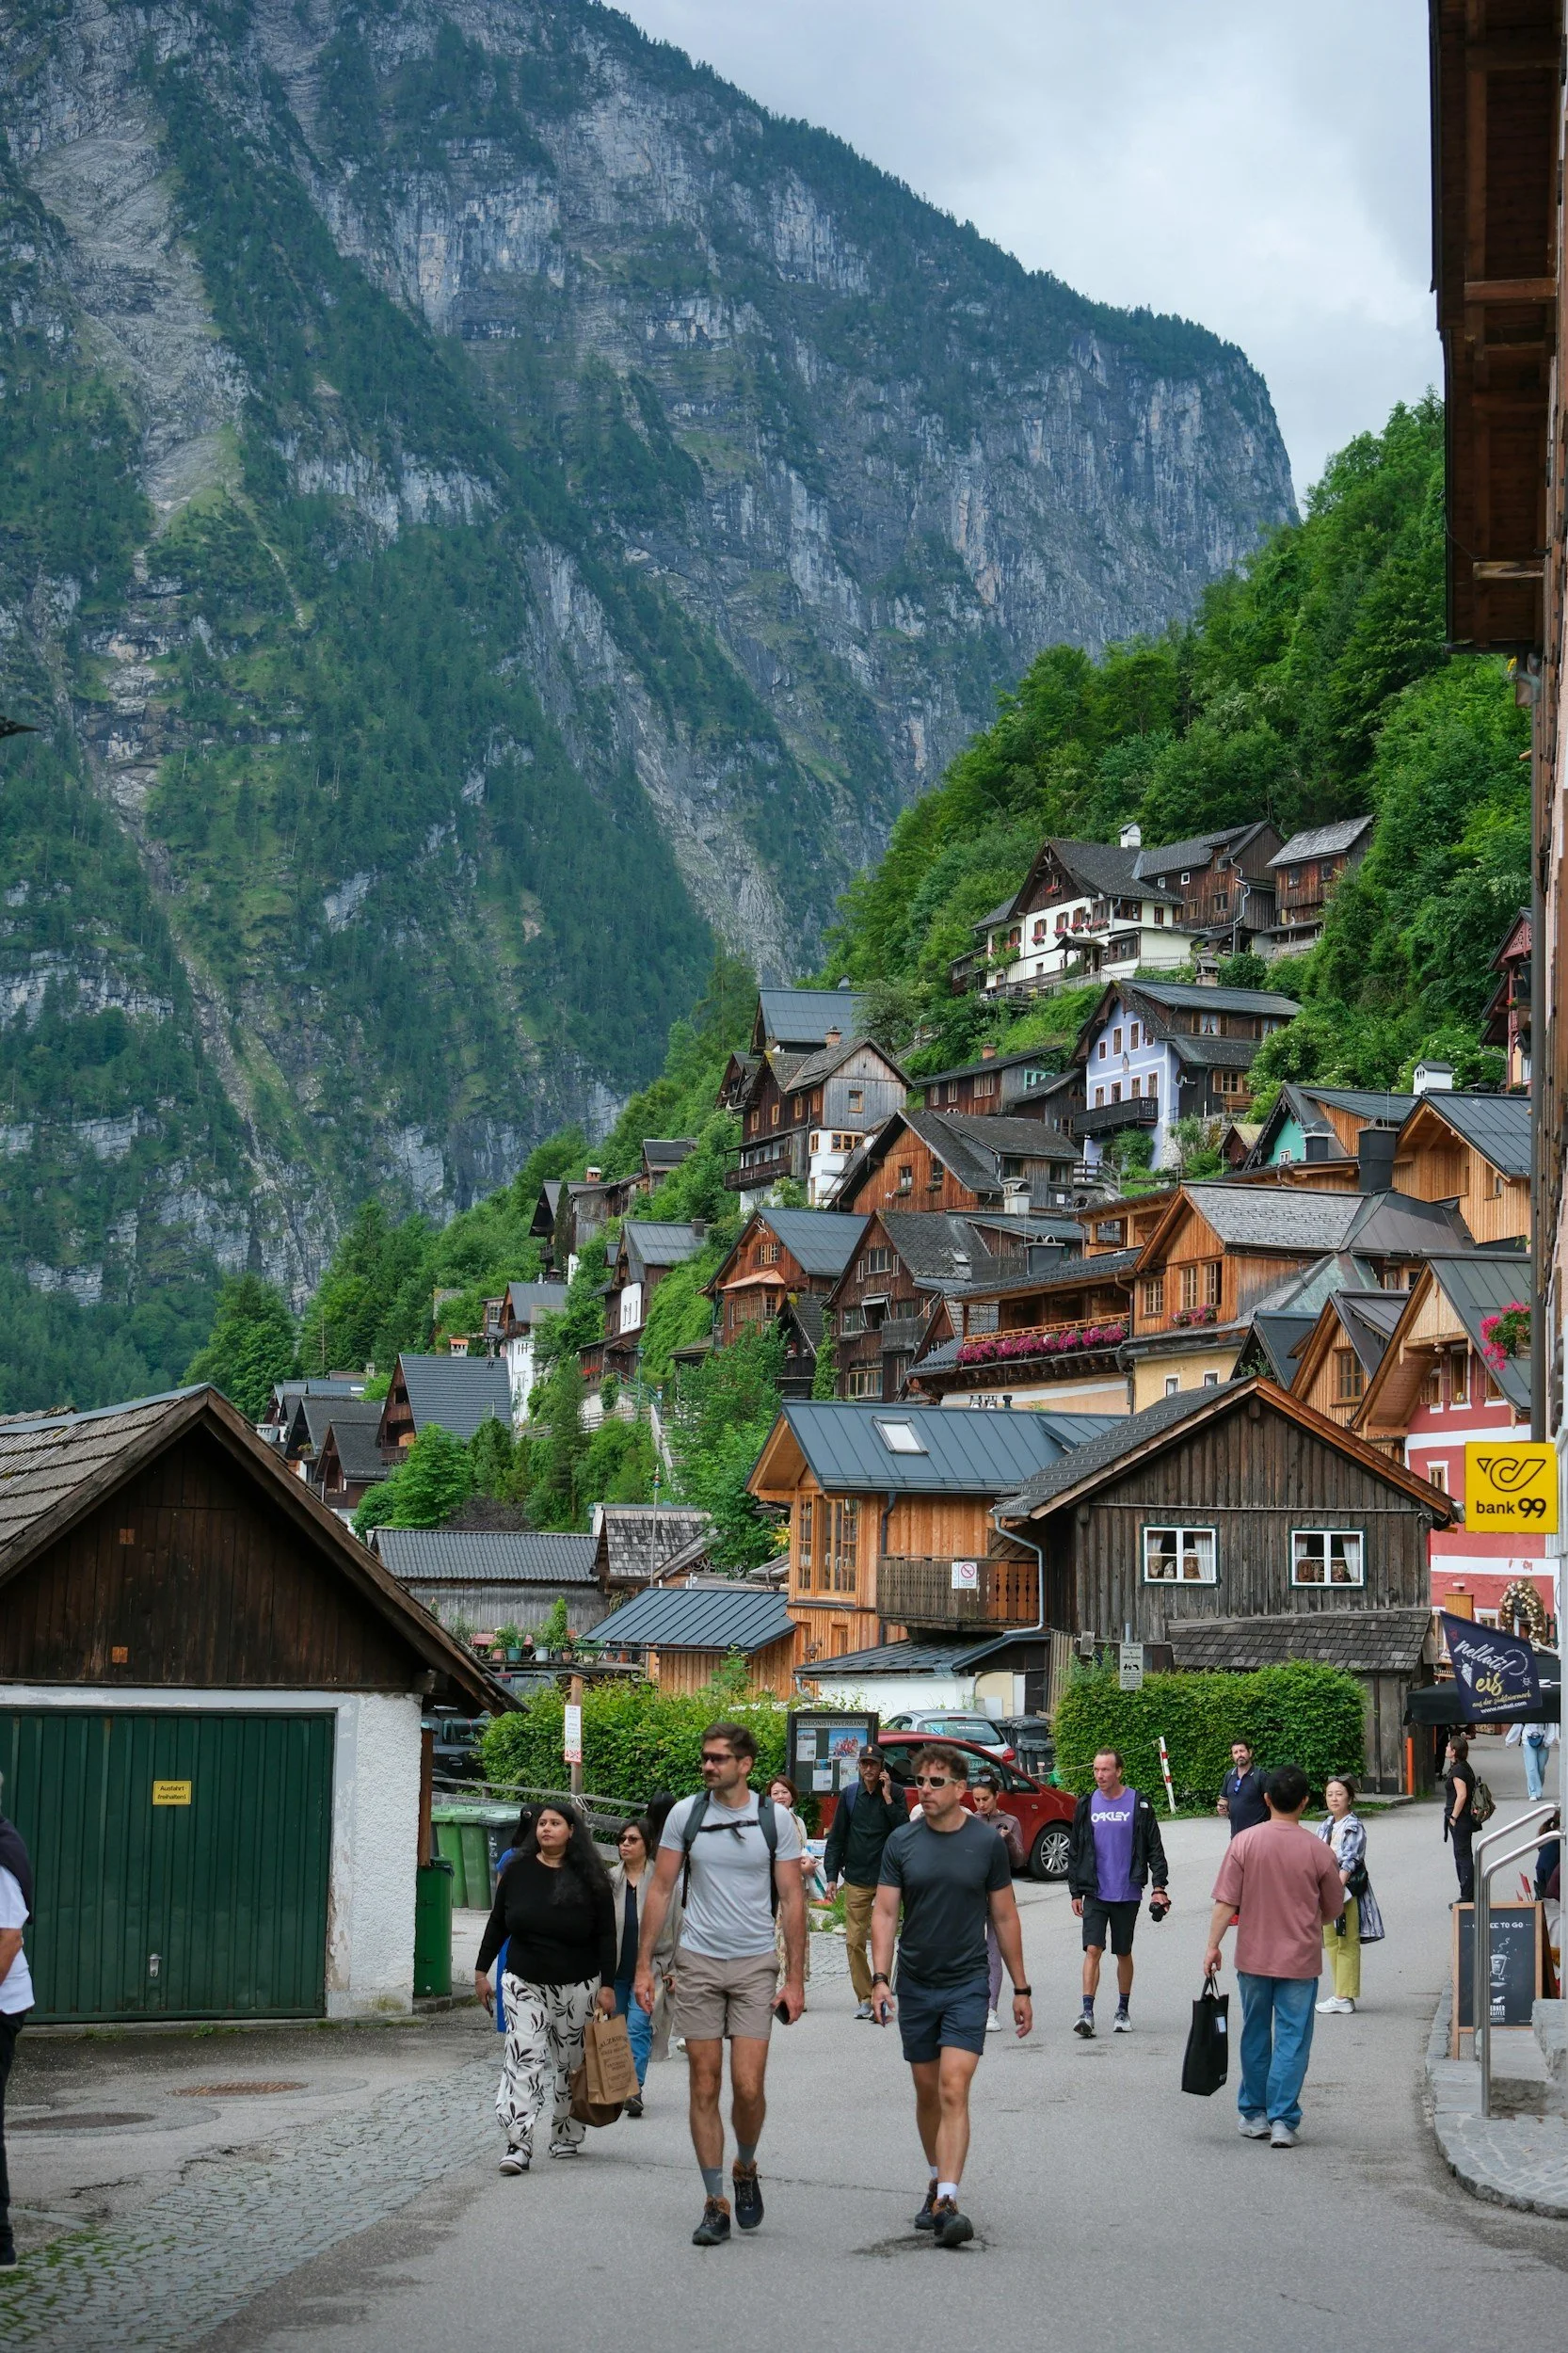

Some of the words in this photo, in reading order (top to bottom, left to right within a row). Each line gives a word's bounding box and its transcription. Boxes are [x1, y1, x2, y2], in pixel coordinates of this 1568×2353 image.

[1476, 1500, 1515, 1513] bank
[1518, 1497, 1546, 1518] 99
[1475, 1672, 1505, 1696] eis
[1480, 1700, 1528, 1714] www.nellati.com
[1091, 1811, 1130, 1822] OAKLEY
